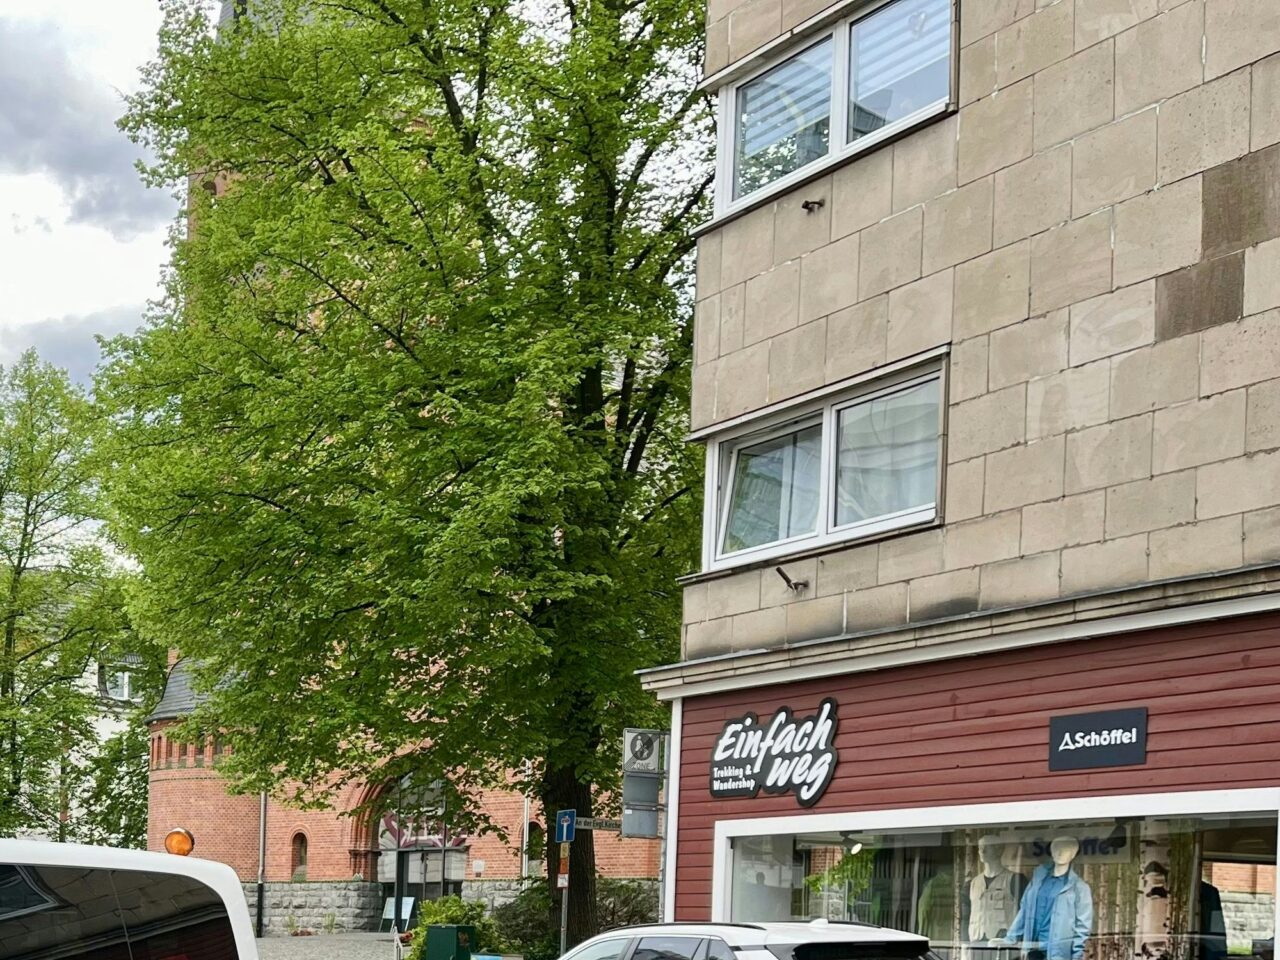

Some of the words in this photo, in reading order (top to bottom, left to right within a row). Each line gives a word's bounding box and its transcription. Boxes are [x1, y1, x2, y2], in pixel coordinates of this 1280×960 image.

[713, 703, 833, 774] Einfach
[1074, 727, 1138, 748] Schöffel
[713, 766, 744, 778] Trekking
[745, 764, 752, 775] &
[766, 752, 833, 800] weg
[713, 777, 756, 791] Wandershop
